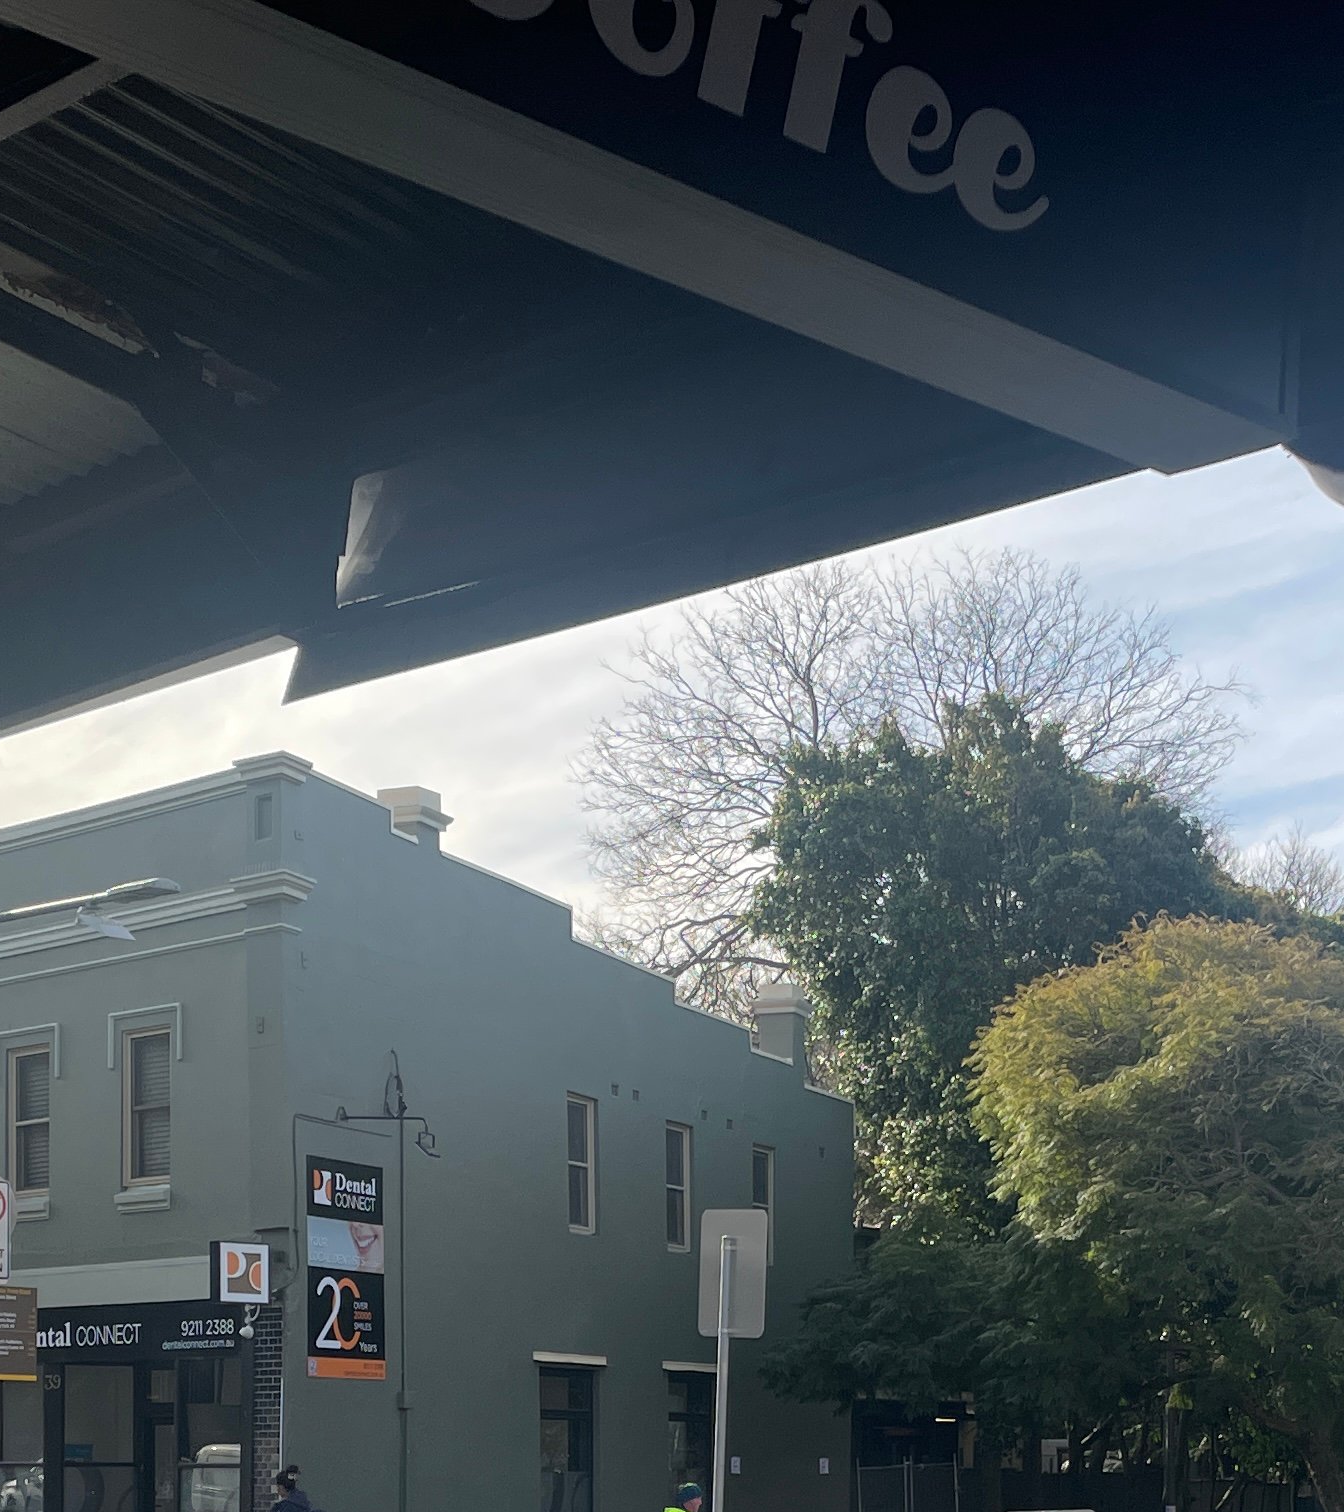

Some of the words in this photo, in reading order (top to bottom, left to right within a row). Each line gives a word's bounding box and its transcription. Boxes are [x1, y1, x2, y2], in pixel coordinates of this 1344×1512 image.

[469, 0, 1049, 231] offee
[335, 1172, 377, 1197] Dental
[334, 1192, 376, 1212] CONNECT
[75, 1323, 142, 1347] CONNECT
[180, 1320, 204, 1337] 9211
[205, 1318, 235, 1335] 2388
[162, 1338, 235, 1351] dentalconnect.com.au
[358, 1341, 378, 1353] Years
[44, 1374, 62, 1390] 39
